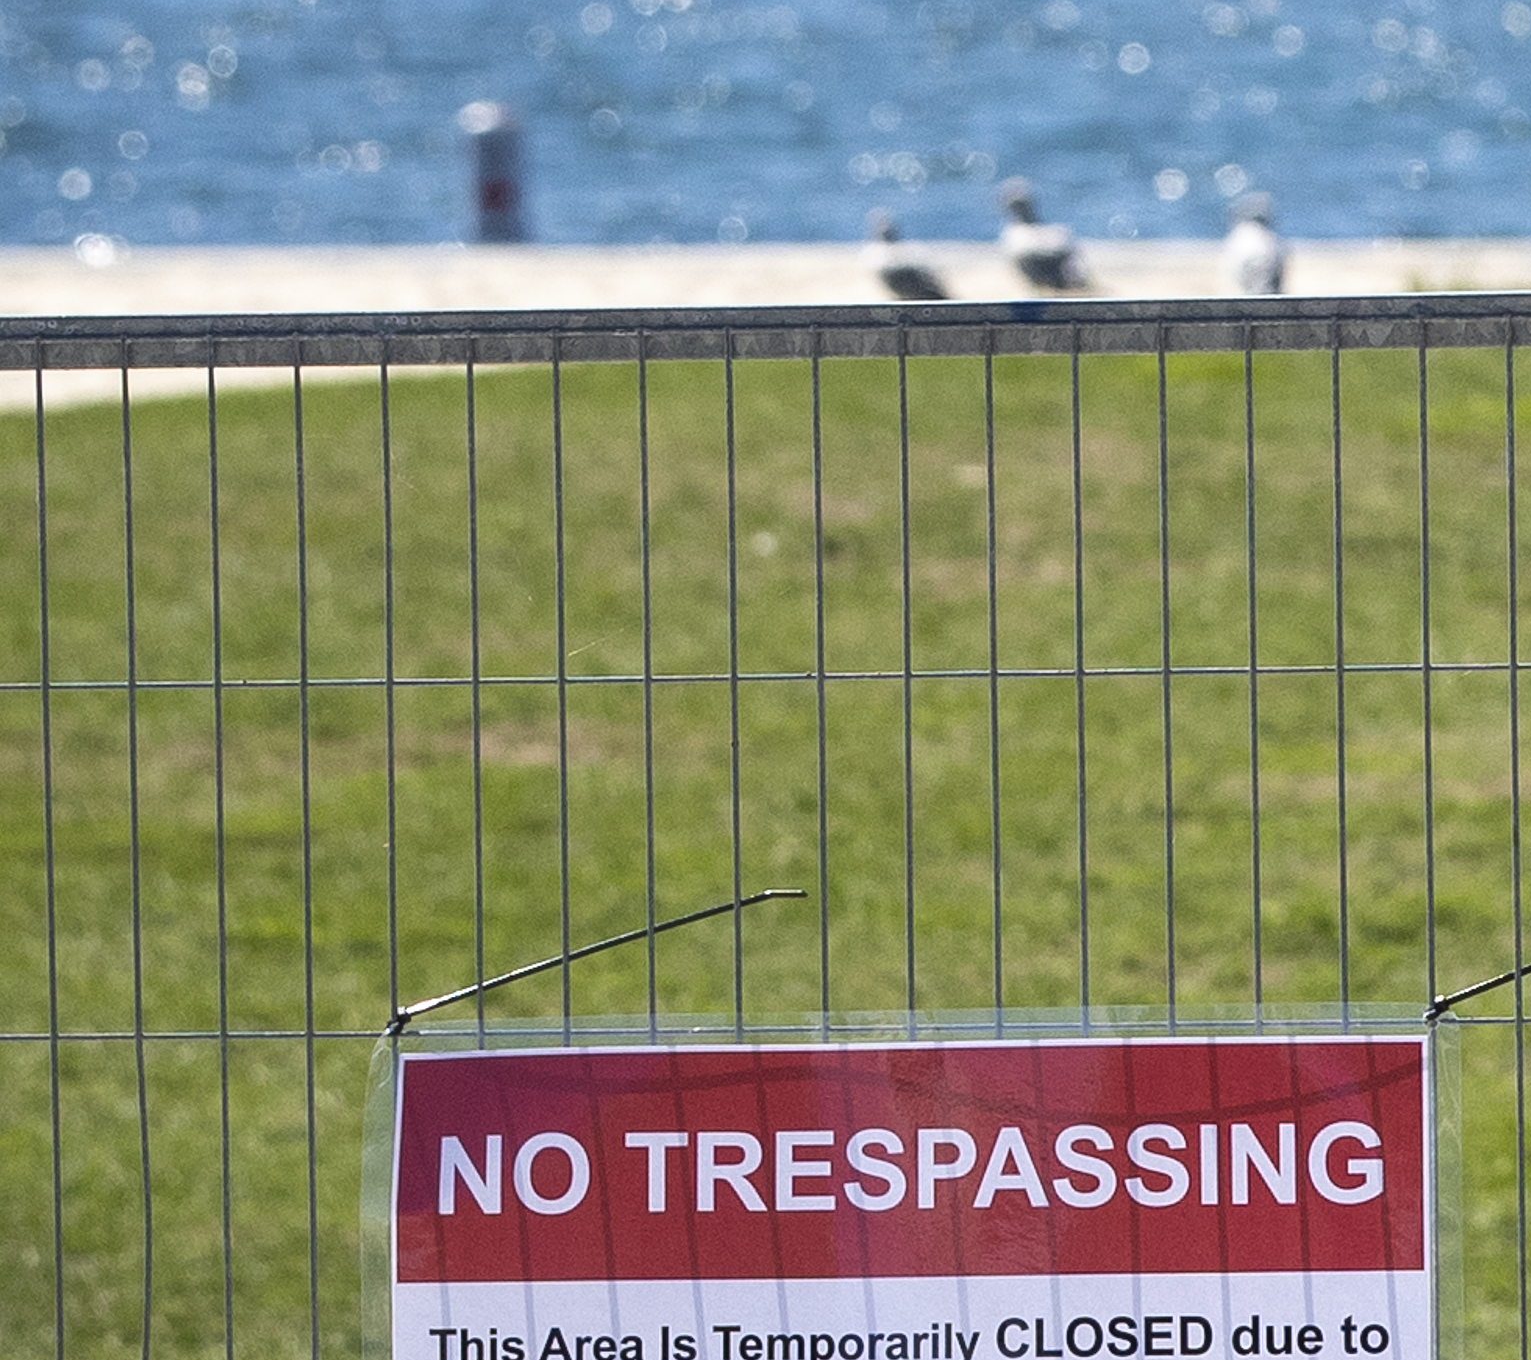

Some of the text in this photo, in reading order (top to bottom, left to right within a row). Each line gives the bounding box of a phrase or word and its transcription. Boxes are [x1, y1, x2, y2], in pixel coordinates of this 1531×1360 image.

[438, 1121, 1384, 1215] NO TRESPASSING
[996, 1316, 1213, 1359] CLOSED
[1231, 1315, 1324, 1356] due
[1340, 1315, 1389, 1355] to
